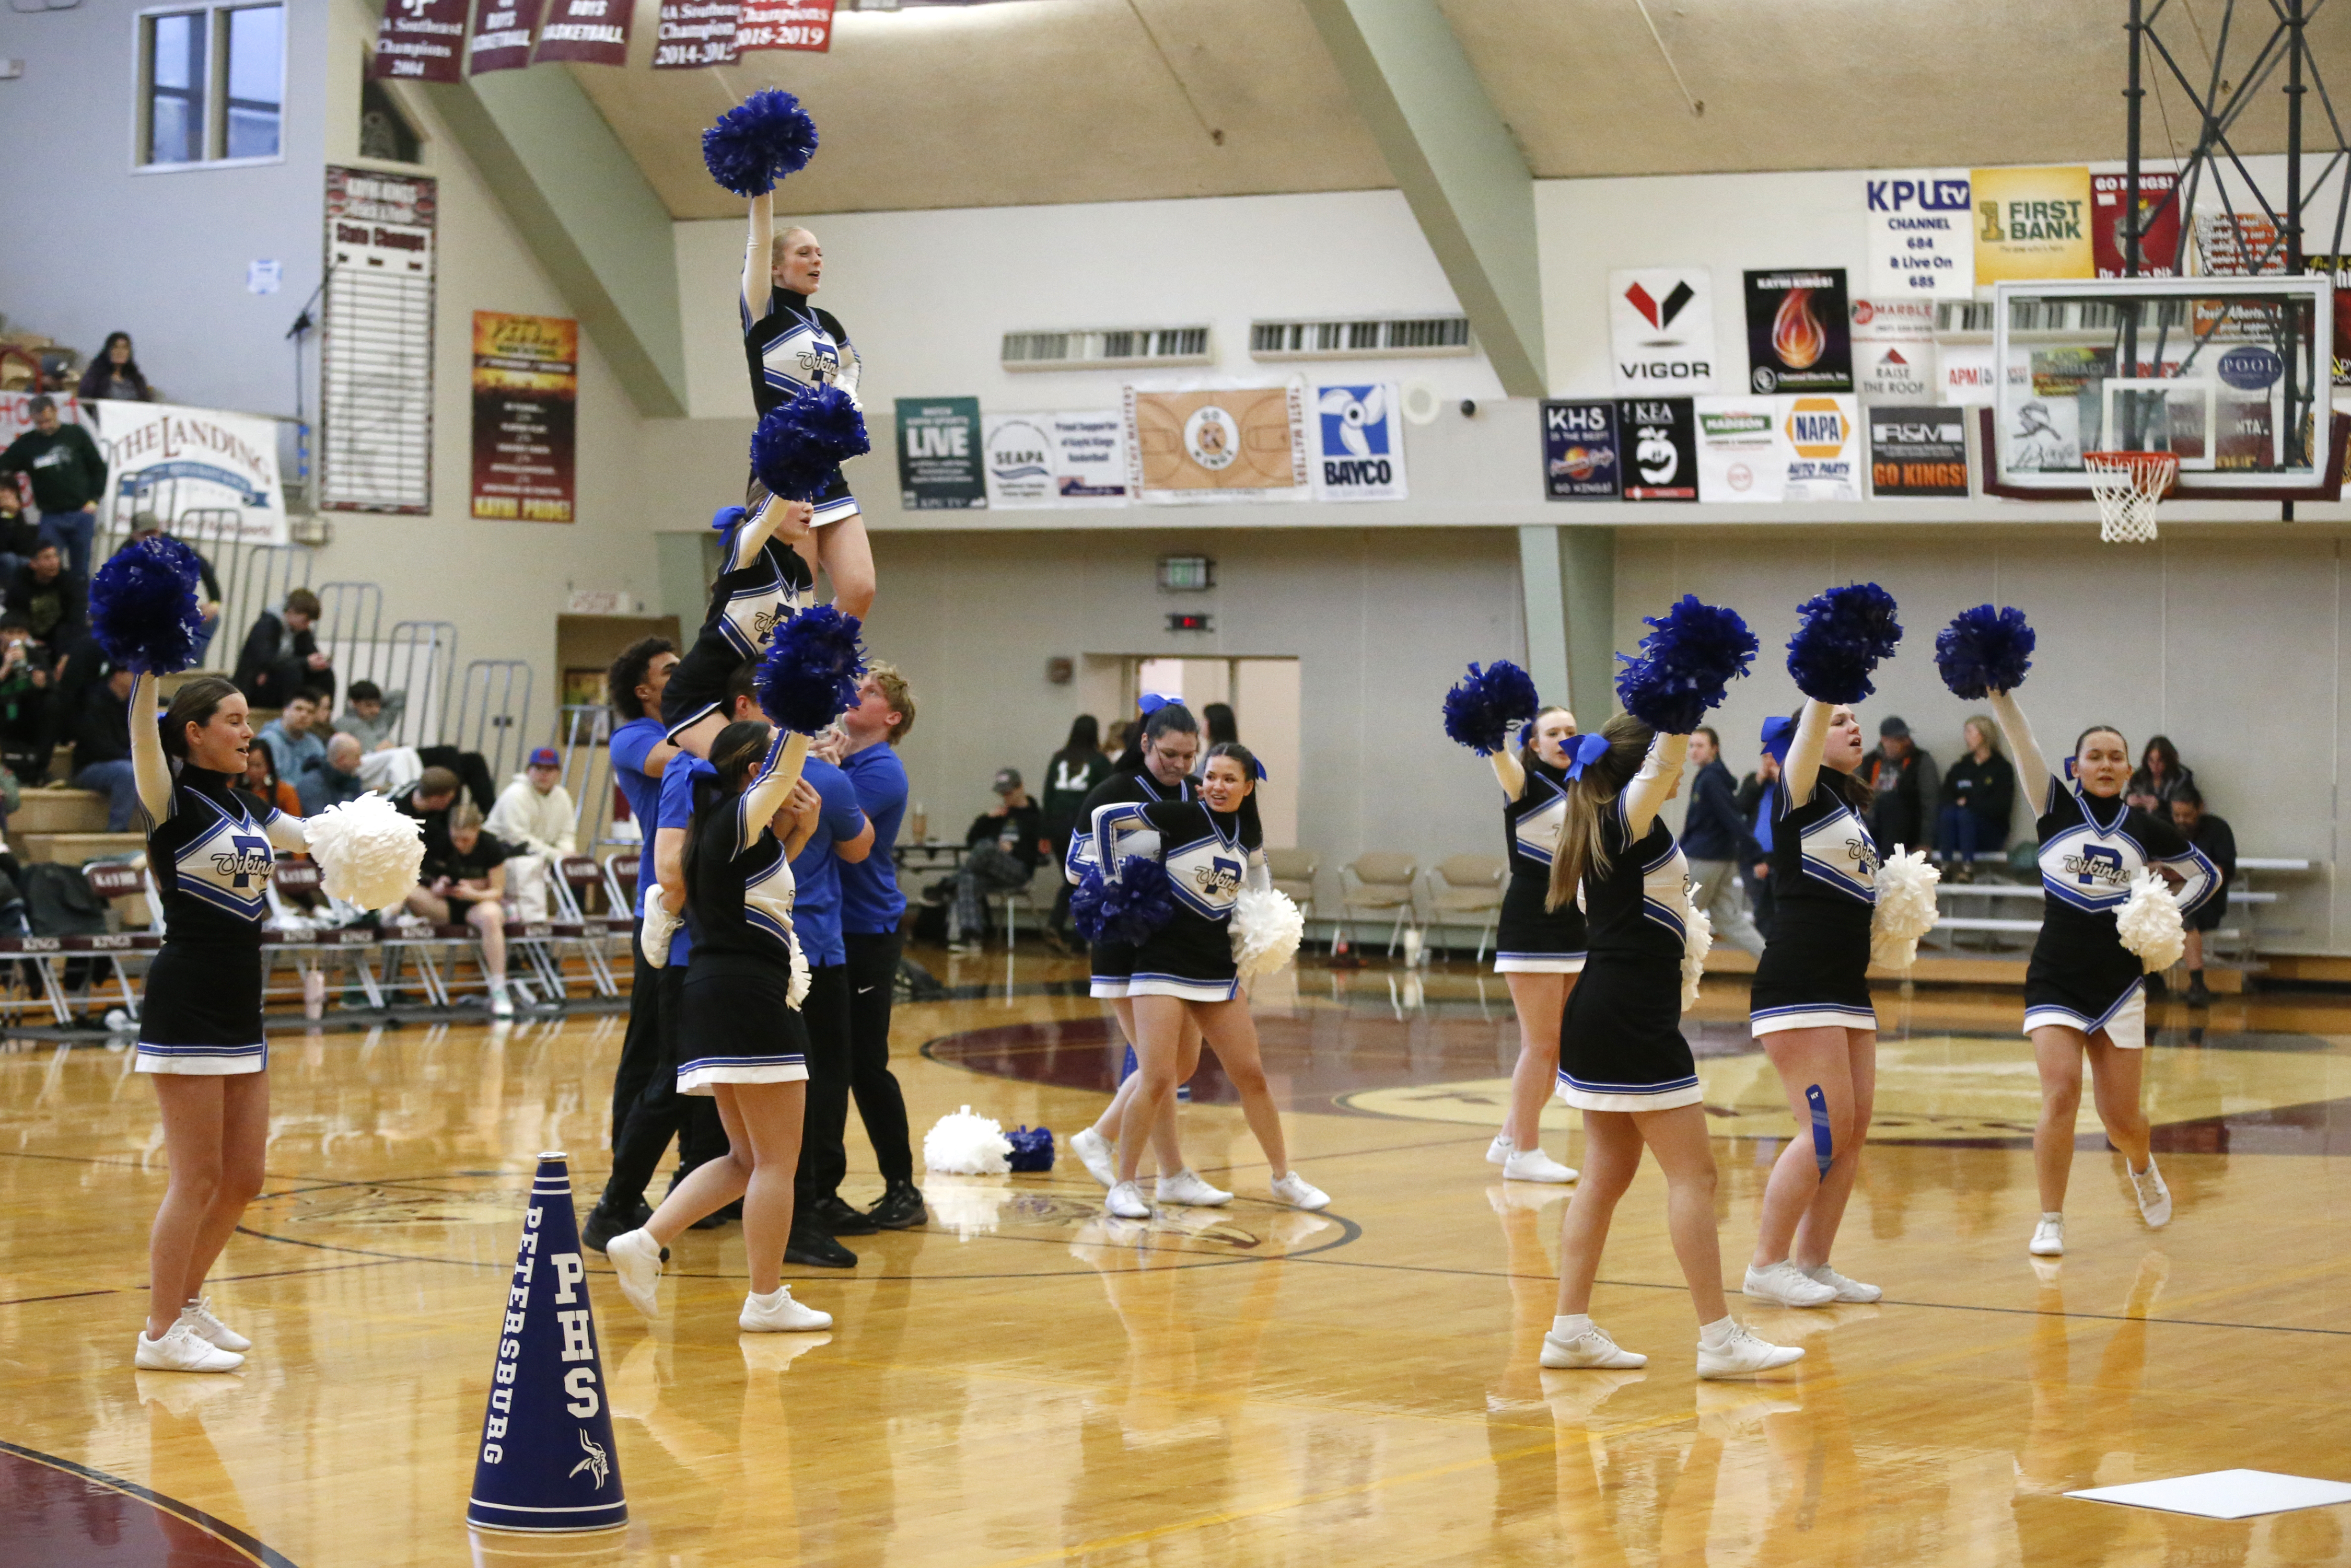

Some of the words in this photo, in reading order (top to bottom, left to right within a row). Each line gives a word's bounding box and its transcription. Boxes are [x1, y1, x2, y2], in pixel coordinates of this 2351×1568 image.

[681, 5, 741, 19] Southeas
[658, 21, 736, 41] Champion
[377, 39, 451, 57] Champions
[2095, 177, 2117, 191] GO
[2119, 176, 2174, 191] KNGS!
[2009, 200, 2081, 219] FIRST
[1888, 217, 1951, 230] CHANNEL
[2011, 222, 2081, 239] BANK
[1902, 255, 1930, 268] Live
[1934, 256, 1952, 268] On
[1875, 304, 1931, 316] MARBLE
[1621, 363, 1711, 378] VIGOR
[1876, 367, 1908, 378] RAISE
[1949, 367, 1977, 385] APM
[1864, 381, 1884, 391] THE
[1889, 381, 1924, 392] ROOF
[1201, 410, 1220, 420] GO
[1549, 407, 1606, 430] KHS
[1636, 401, 1673, 421] KEA
[1706, 419, 1765, 430] MADISON
[1796, 416, 1839, 442] NAPA
[108, 421, 160, 468] THE
[906, 427, 970, 458] LIVE
[1563, 431, 1579, 440] THE
[996, 450, 1044, 465] SEAPA
[1323, 460, 1392, 485] BAYCO
[1788, 462, 1815, 473] AUTO
[1819, 462, 1849, 473] PARTS
[1873, 462, 1900, 486] GO
[1903, 462, 1966, 487] KINGS!
[1555, 482, 1571, 493] GO
[1054, 760, 1089, 791] 12
[211, 849, 275, 885] Viking
[2064, 854, 2131, 884] Vikings
[2078, 844, 2122, 885] P
[1195, 866, 1242, 898] Viking
[1205, 856, 1242, 895] P
[1810, 1091, 1819, 1100] KT
[483, 1206, 544, 1465] PETERSBURG
[551, 1252, 600, 1419] PHS
